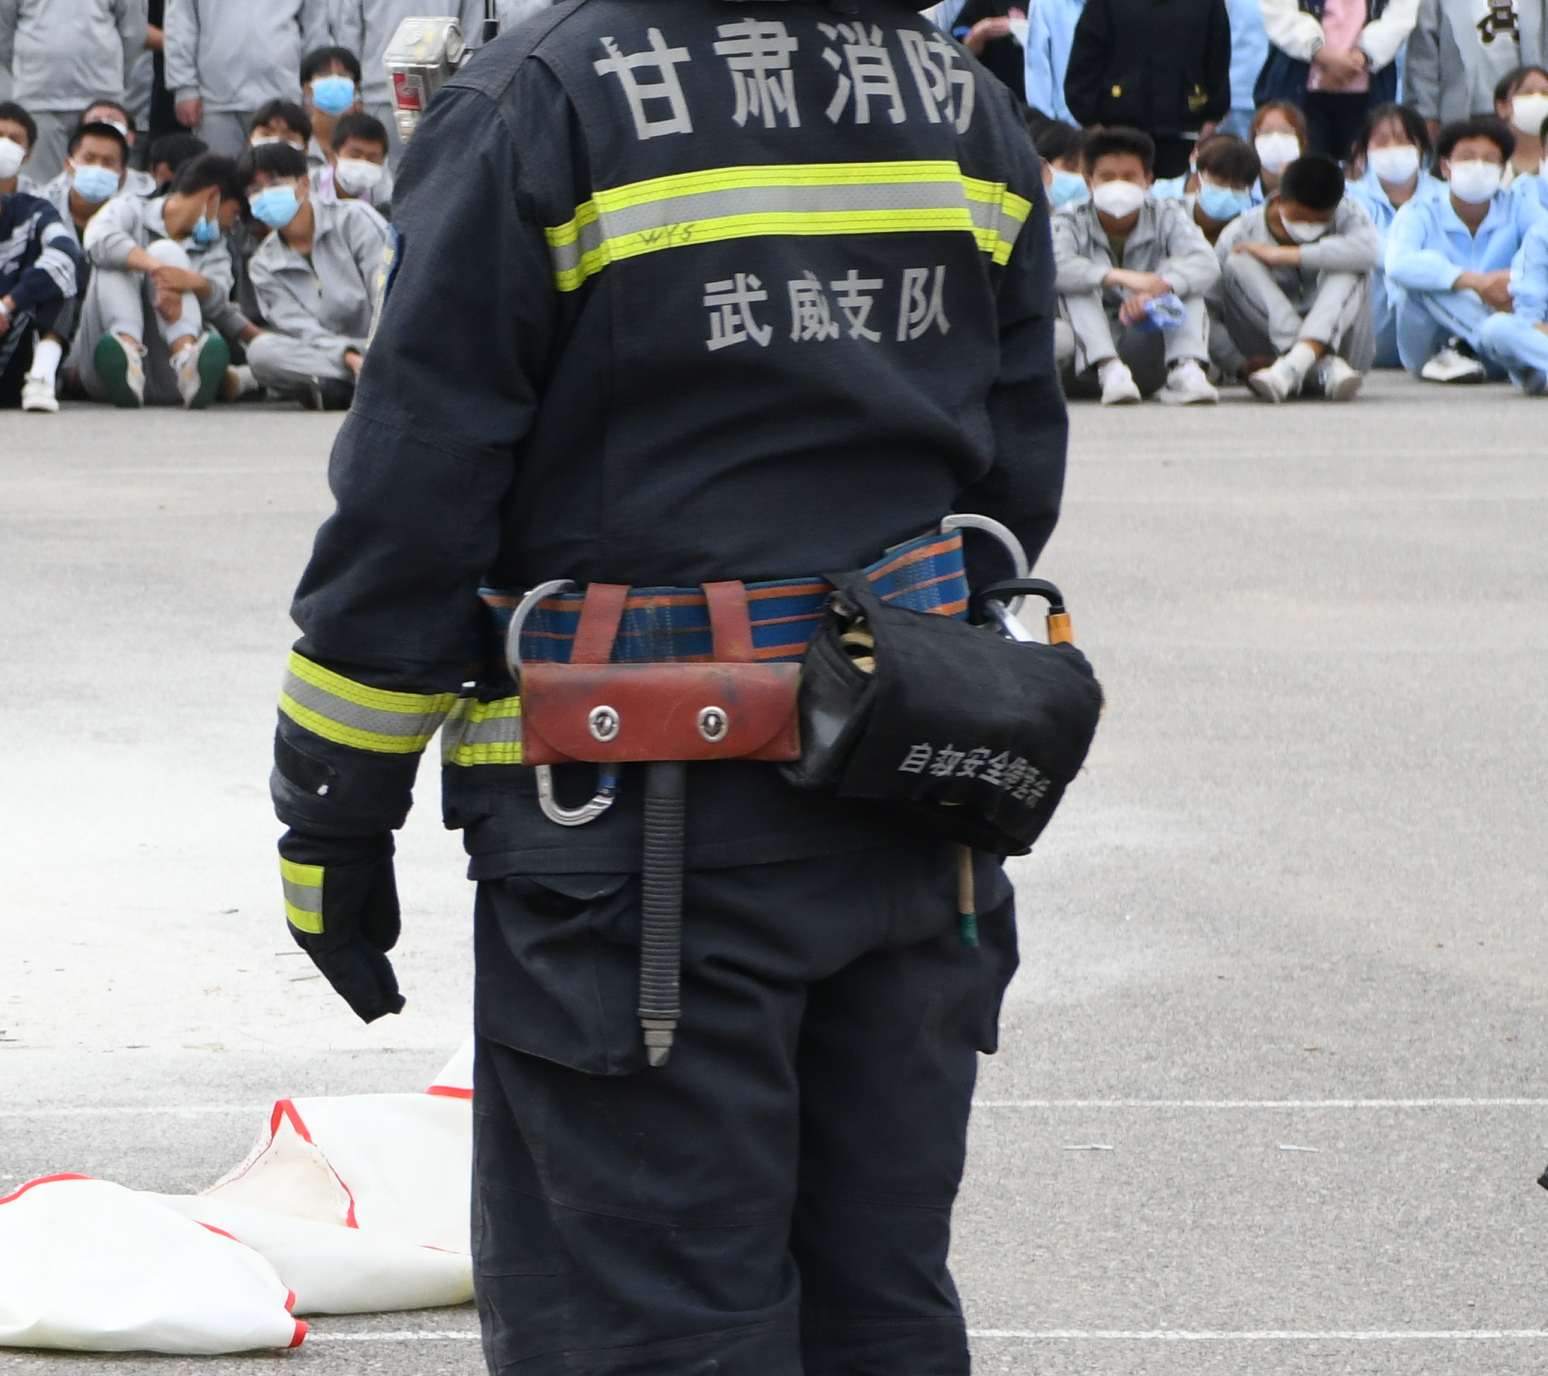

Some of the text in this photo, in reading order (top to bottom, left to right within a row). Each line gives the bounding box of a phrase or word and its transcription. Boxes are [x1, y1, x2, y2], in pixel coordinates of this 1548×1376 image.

[594, 18, 976, 141] 甘肃消防
[703, 265, 951, 352] 武威支队
